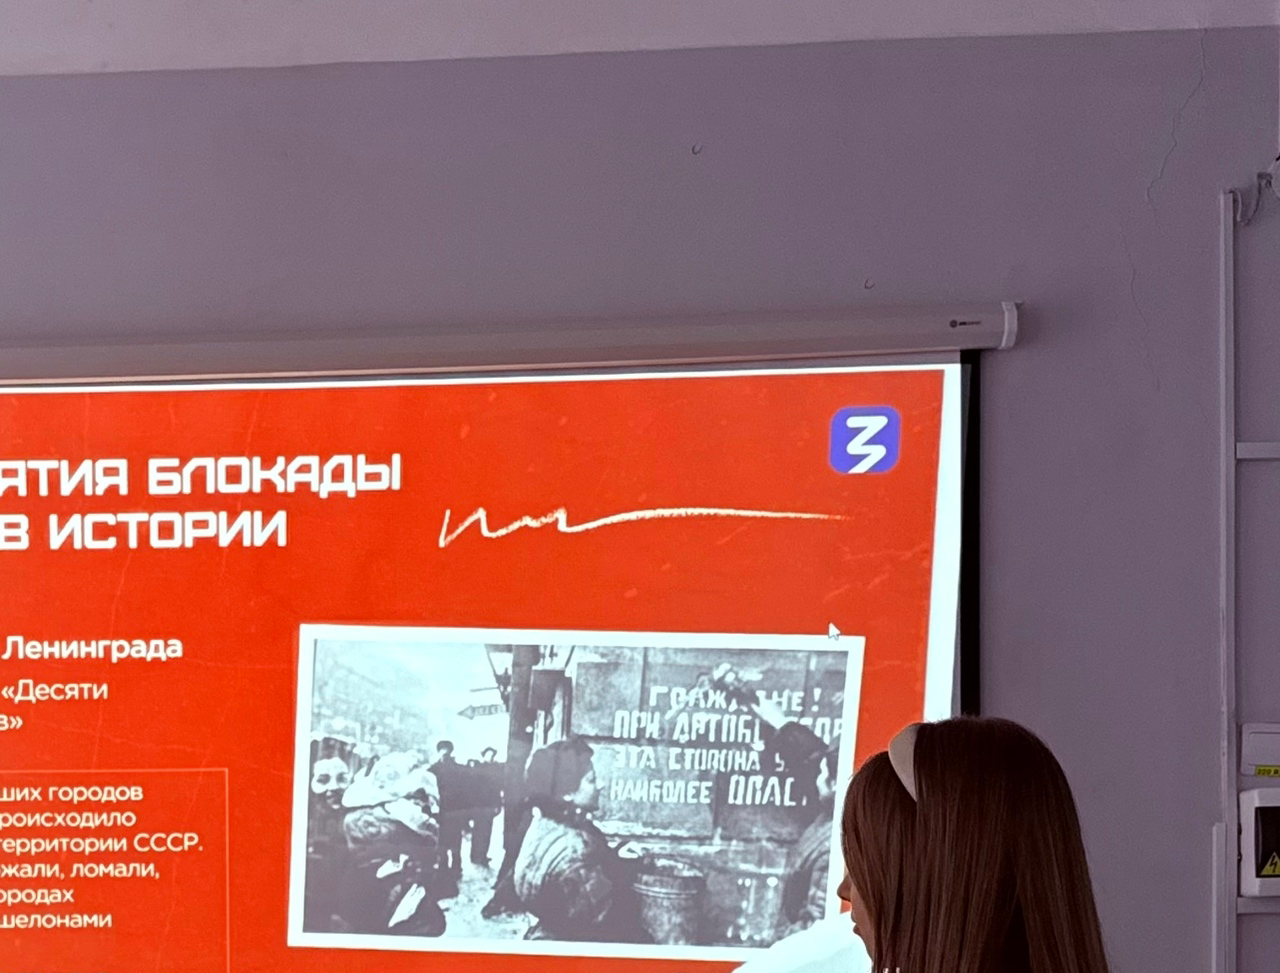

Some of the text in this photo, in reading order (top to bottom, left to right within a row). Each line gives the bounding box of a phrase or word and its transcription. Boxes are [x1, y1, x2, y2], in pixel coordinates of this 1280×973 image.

[147, 453, 401, 499] БЛОКАДЫ
[48, 509, 287, 551] ИСТОРИИ
[1, 635, 183, 664] Ленинграда
[1, 678, 109, 705] «Десяти
[48, 785, 144, 805] городов
[133, 832, 204, 853] СССР.
[70, 862, 161, 881] ломали,
